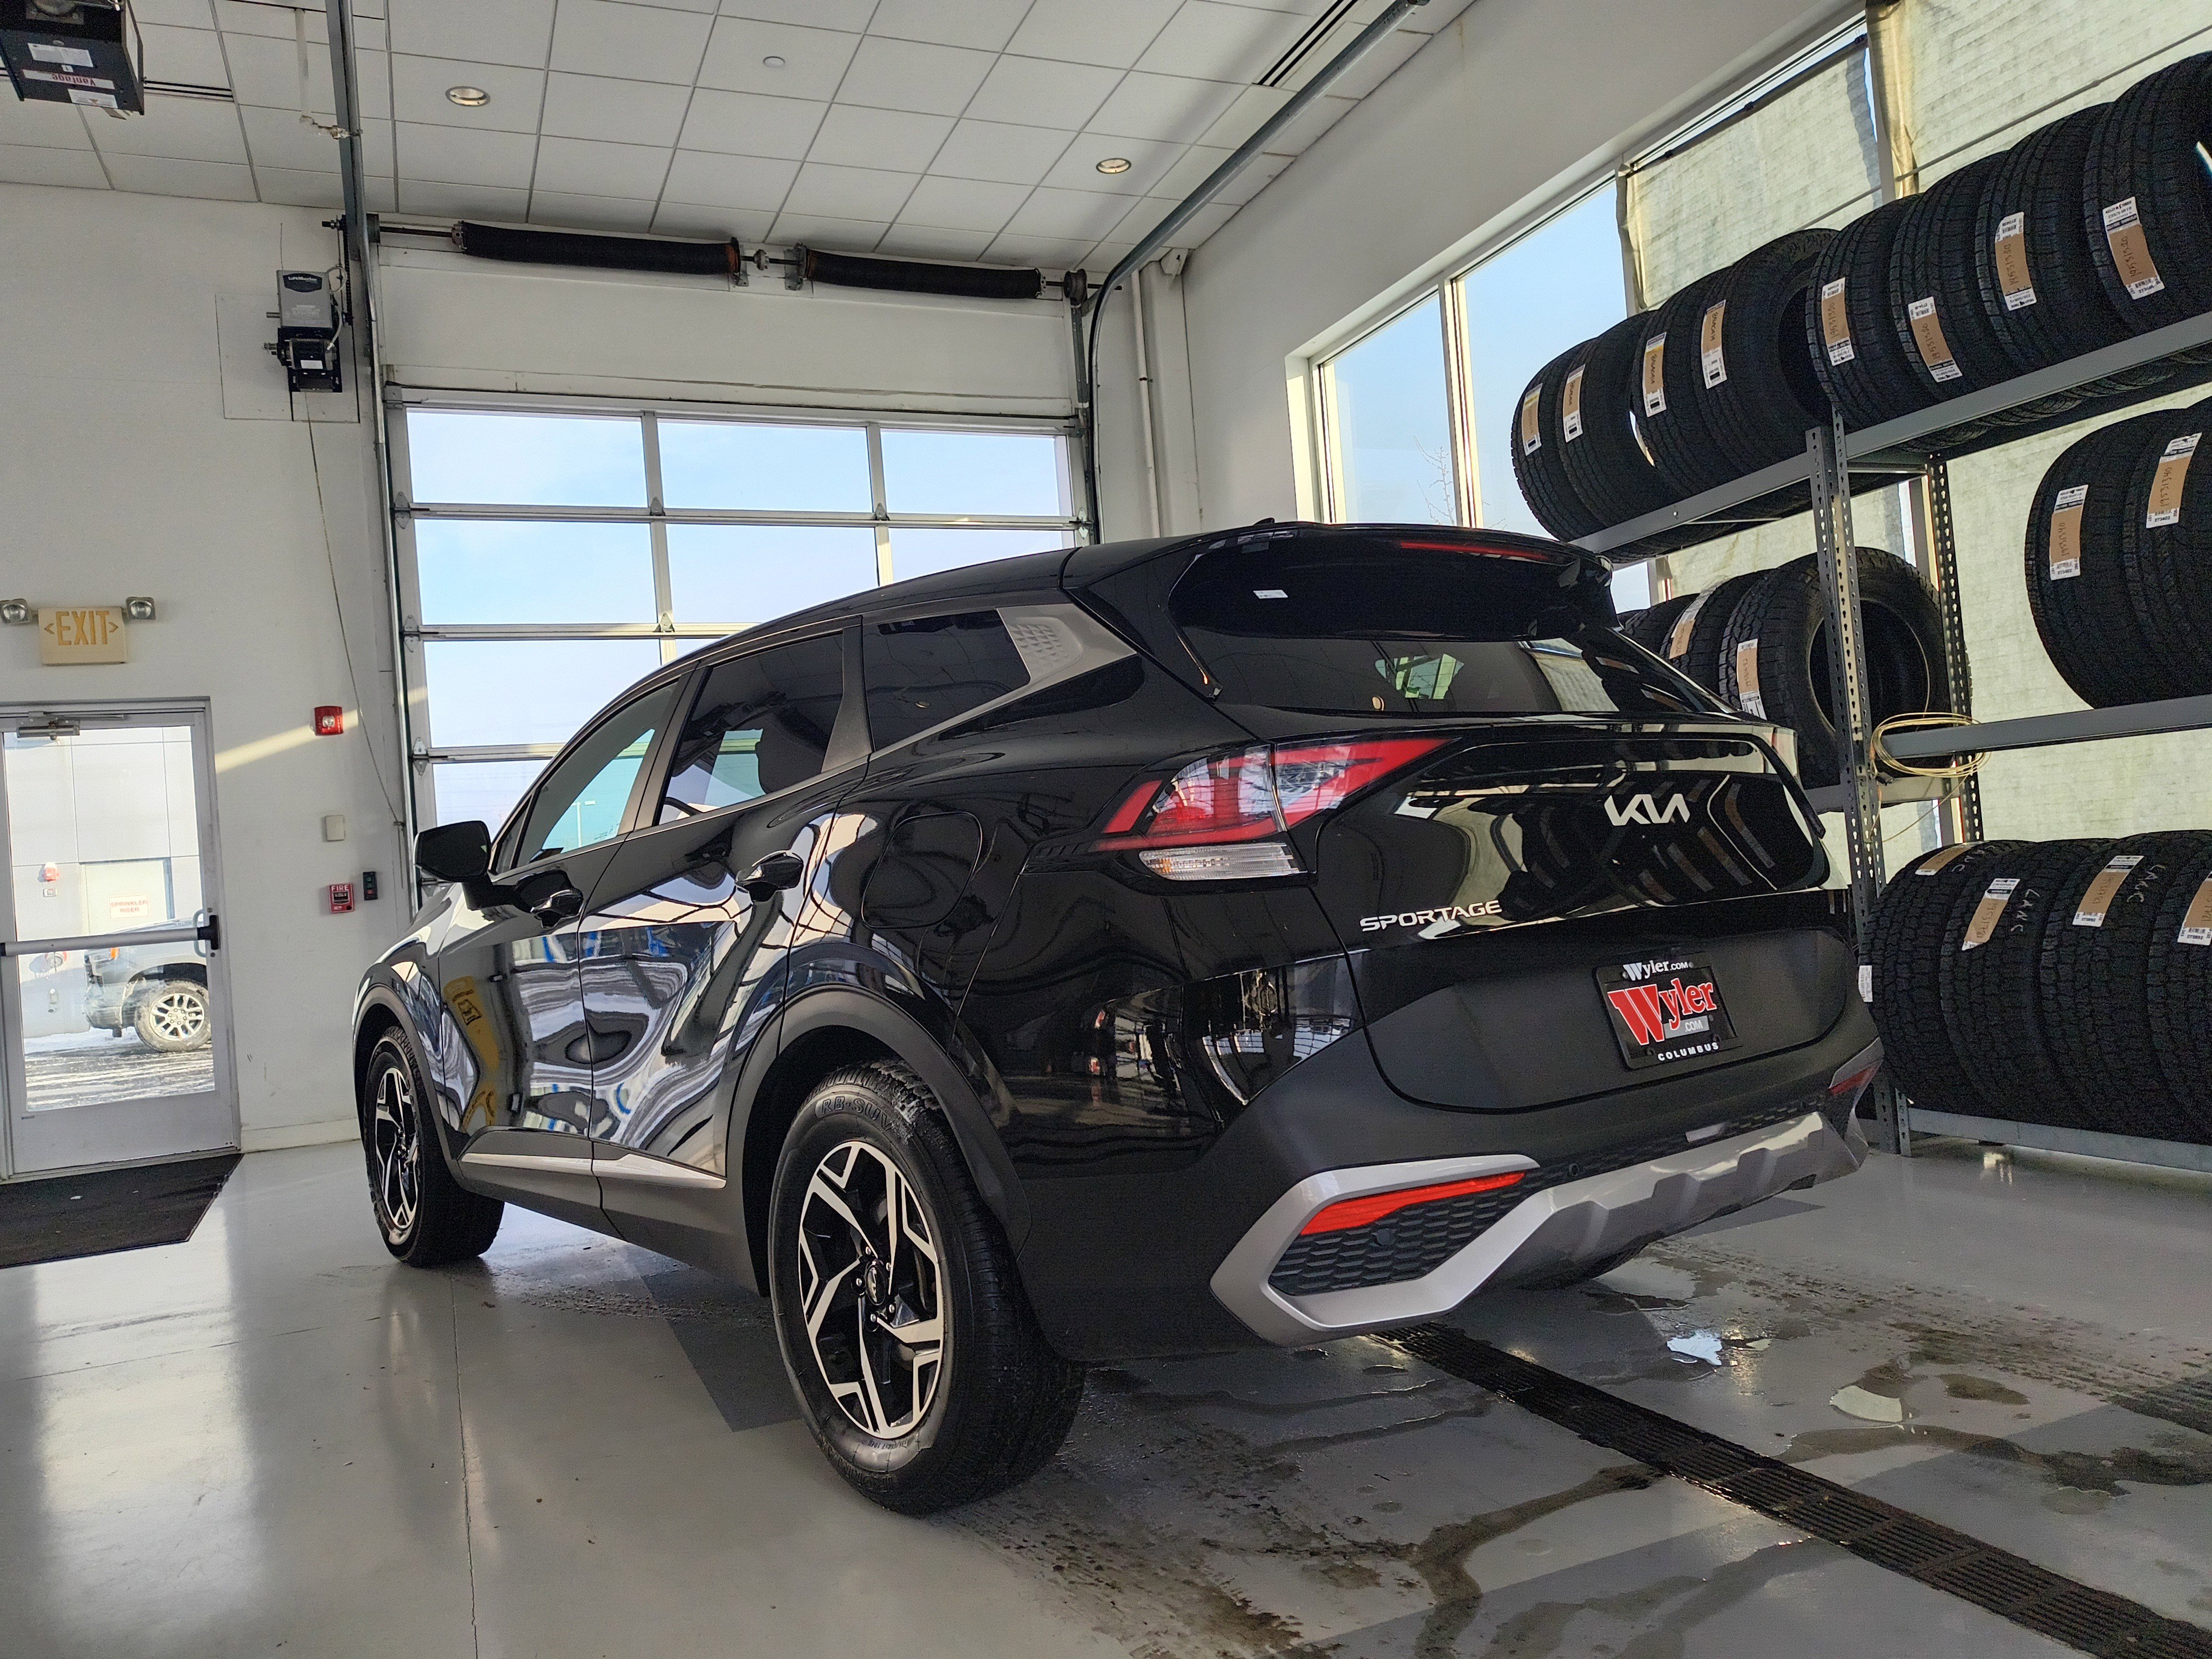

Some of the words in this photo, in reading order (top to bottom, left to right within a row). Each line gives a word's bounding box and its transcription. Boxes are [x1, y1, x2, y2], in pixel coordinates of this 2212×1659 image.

[52, 73, 96, 86] Vantage
[56, 611, 109, 645] EXIT
[1604, 793, 1690, 826] KIA
[1359, 900, 1502, 932] SPORTAGE
[1607, 977, 1717, 1046] Wyler
[1657, 1042, 1718, 1061] COLUMBUS
